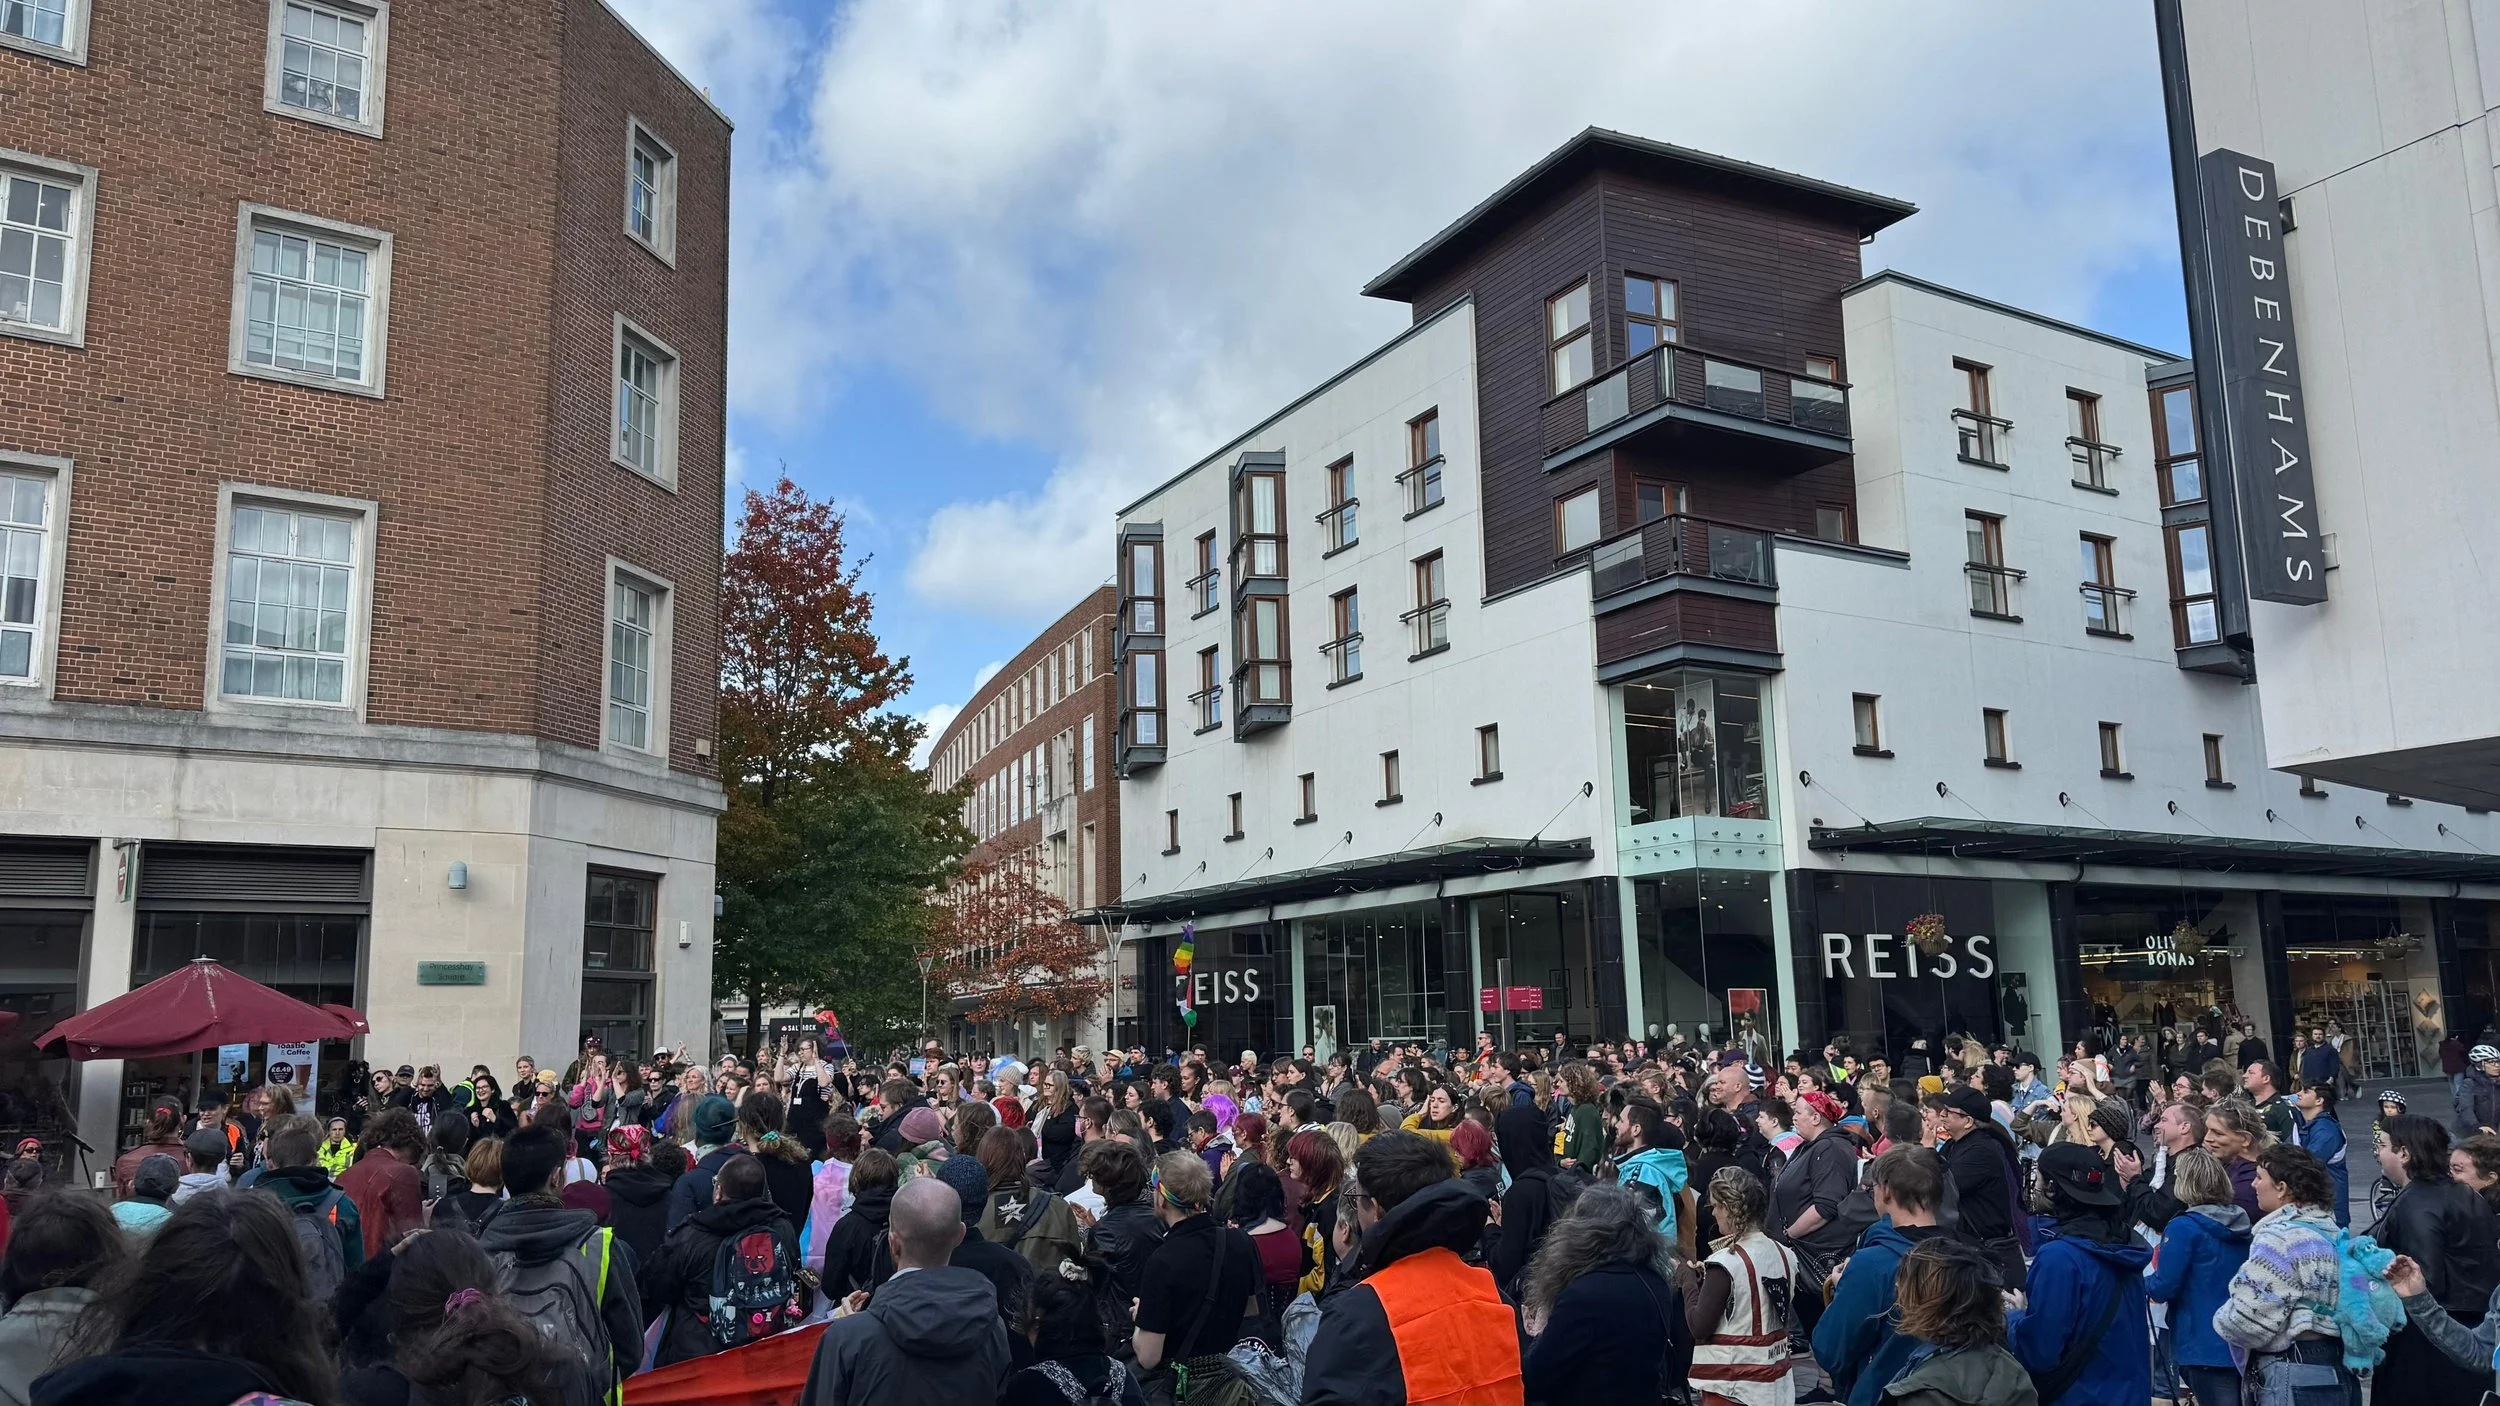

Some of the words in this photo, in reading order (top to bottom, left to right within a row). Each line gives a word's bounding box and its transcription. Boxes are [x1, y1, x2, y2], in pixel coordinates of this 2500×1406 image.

[2237, 165, 2313, 583] DEBENHAMS
[1821, 933, 1994, 979] REISS
[2148, 951, 2195, 966] BONAS
